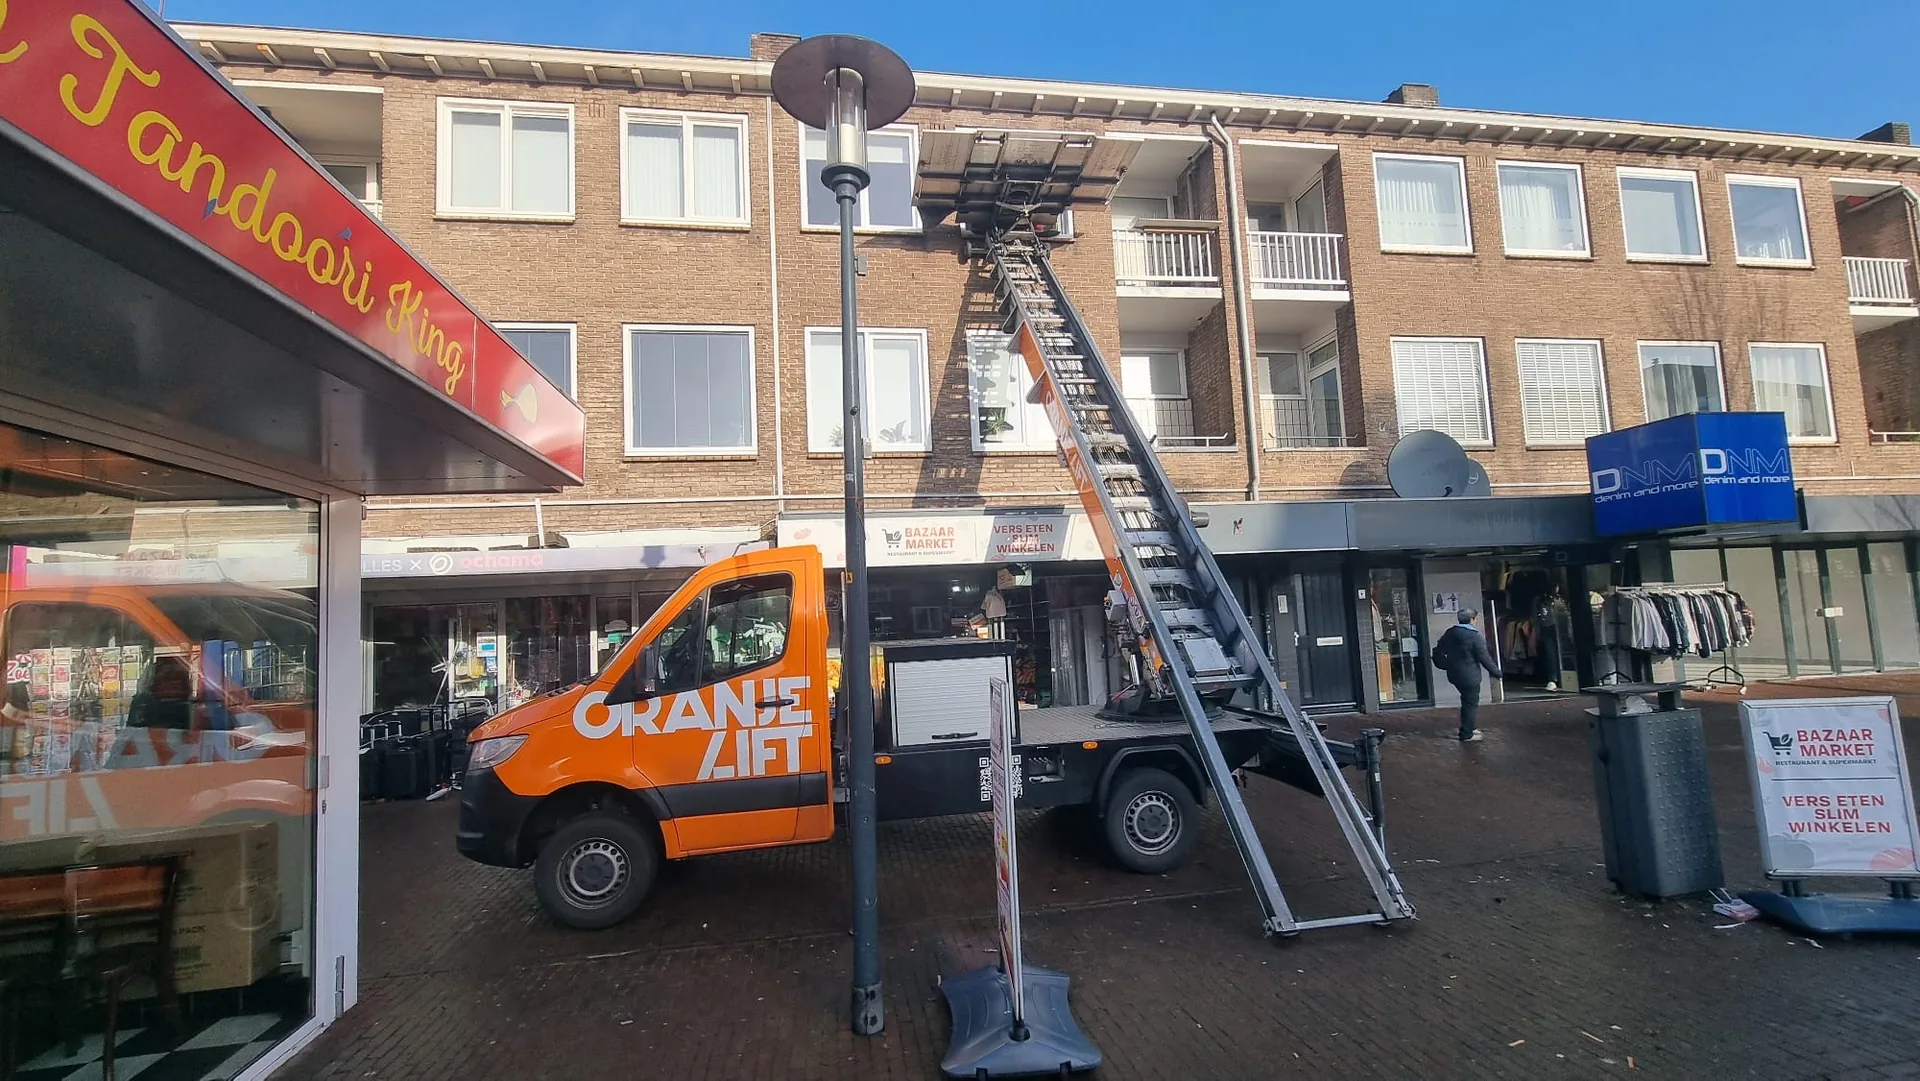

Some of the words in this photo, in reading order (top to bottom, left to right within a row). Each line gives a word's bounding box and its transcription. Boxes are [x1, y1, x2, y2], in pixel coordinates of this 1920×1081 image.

[59, 13, 375, 313] Tandoori
[386, 279, 466, 396] King
[1700, 447, 1790, 474] DNM
[1592, 453, 1698, 494] DNM
[1703, 475, 1737, 484] denim
[1738, 475, 1760, 484] and
[1762, 475, 1791, 484] more
[1595, 492, 1631, 504] denim
[1633, 487, 1660, 498] and
[1662, 480, 1699, 493] more
[905, 526, 955, 538] BAZAAR
[993, 524, 1023, 534] VERS
[1025, 524, 1053, 533] ETEN
[905, 538, 955, 549] MARKET
[996, 543, 1055, 553] WINKELEN
[459, 553, 543, 569] ochama
[572, 676, 813, 740] ORANJE
[1796, 728, 1874, 742] BAZAAR
[696, 725, 813, 782] LIFT
[1800, 743, 1875, 757] MARKET
[1782, 795, 1831, 807] VERS
[1836, 794, 1885, 806] ETEN
[1814, 808, 1860, 820] SLIM
[1788, 821, 1891, 833] WINKELEN
